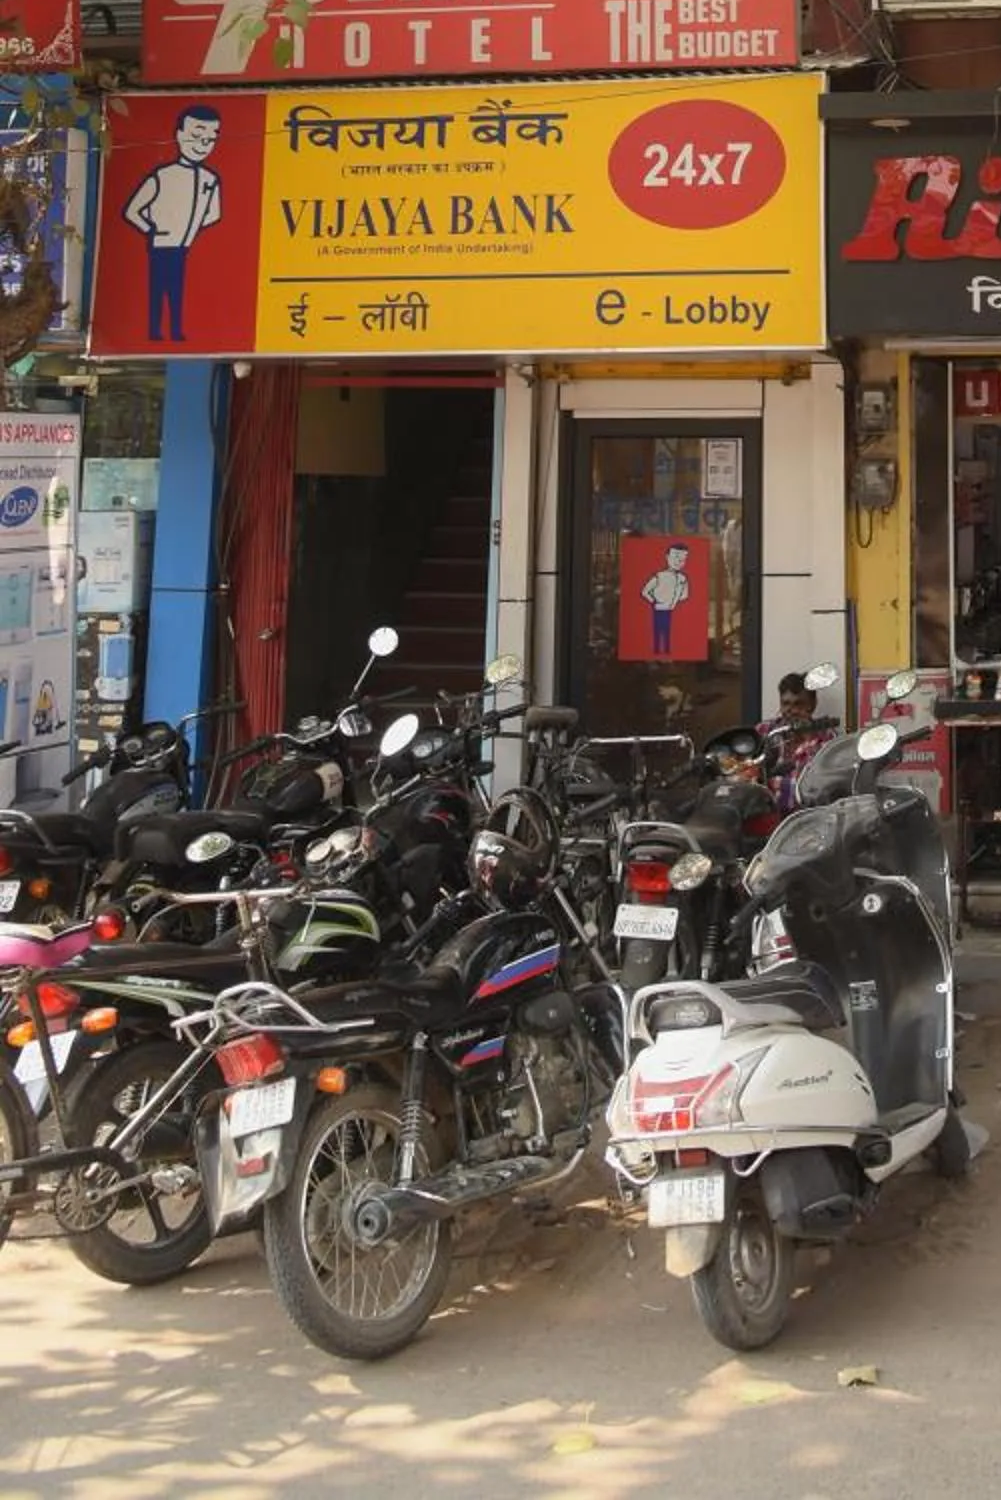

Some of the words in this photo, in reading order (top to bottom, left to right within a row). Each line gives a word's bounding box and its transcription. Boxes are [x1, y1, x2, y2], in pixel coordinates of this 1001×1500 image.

[678, 29, 779, 59] BUDGET
[284, 104, 454, 153] विजया
[469, 98, 568, 148] बैंक
[642, 141, 754, 188] 24x7
[280, 196, 436, 239] VIJAYA
[448, 193, 576, 236] BANK
[333, 245, 406, 257] Government
[409, 244, 420, 255] of
[423, 243, 453, 255] India
[286, 292, 311, 337] ई
[359, 292, 430, 332] लॉबी
[595, 288, 627, 327] e
[664, 294, 771, 330] Lobby
